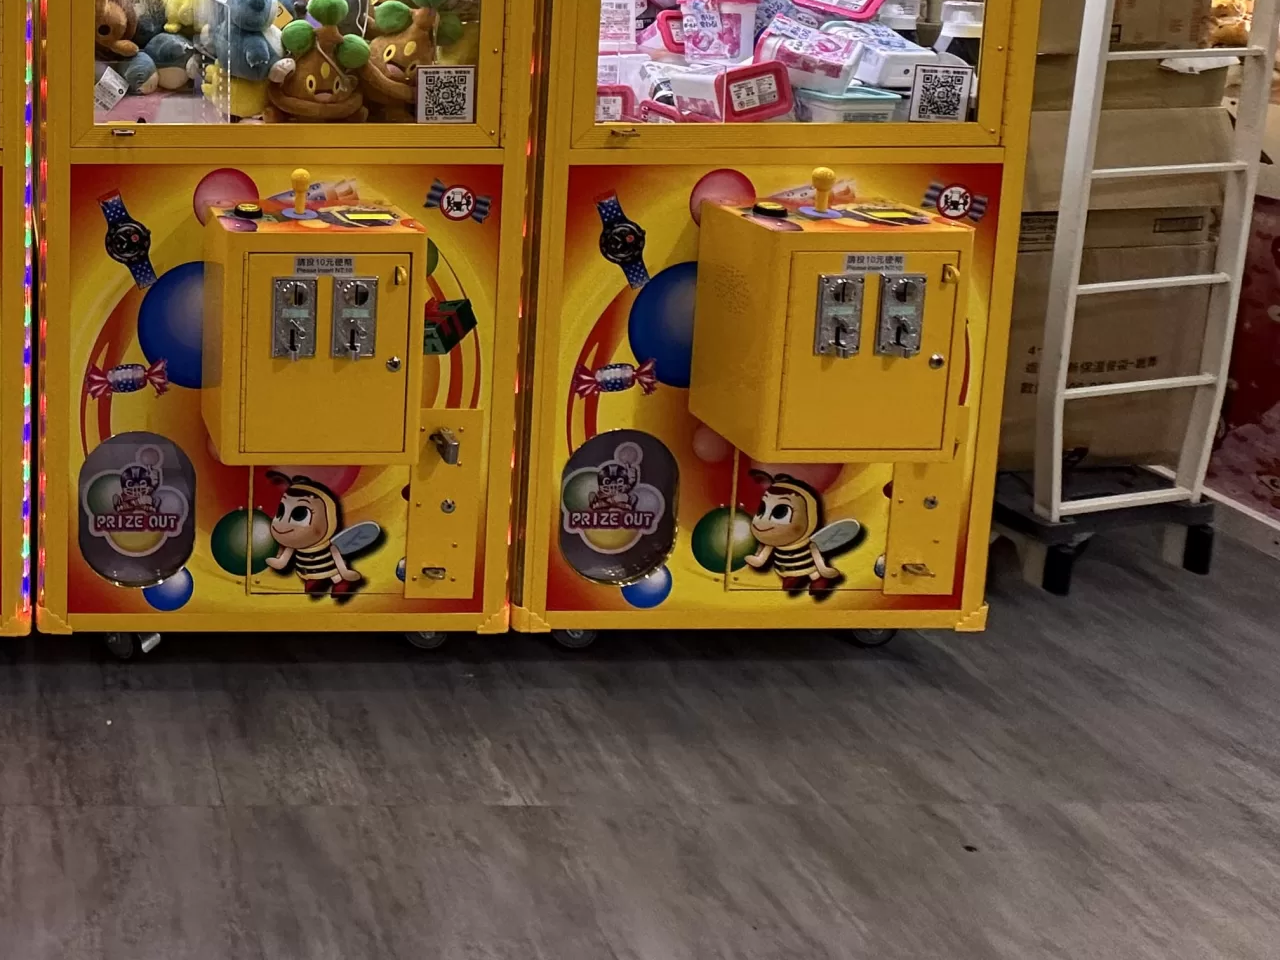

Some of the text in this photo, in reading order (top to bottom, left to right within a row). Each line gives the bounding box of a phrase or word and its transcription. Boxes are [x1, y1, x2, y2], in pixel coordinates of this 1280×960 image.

[96, 515, 178, 529] PRIZE OUT
[571, 512, 653, 526] PRIZE OUT
